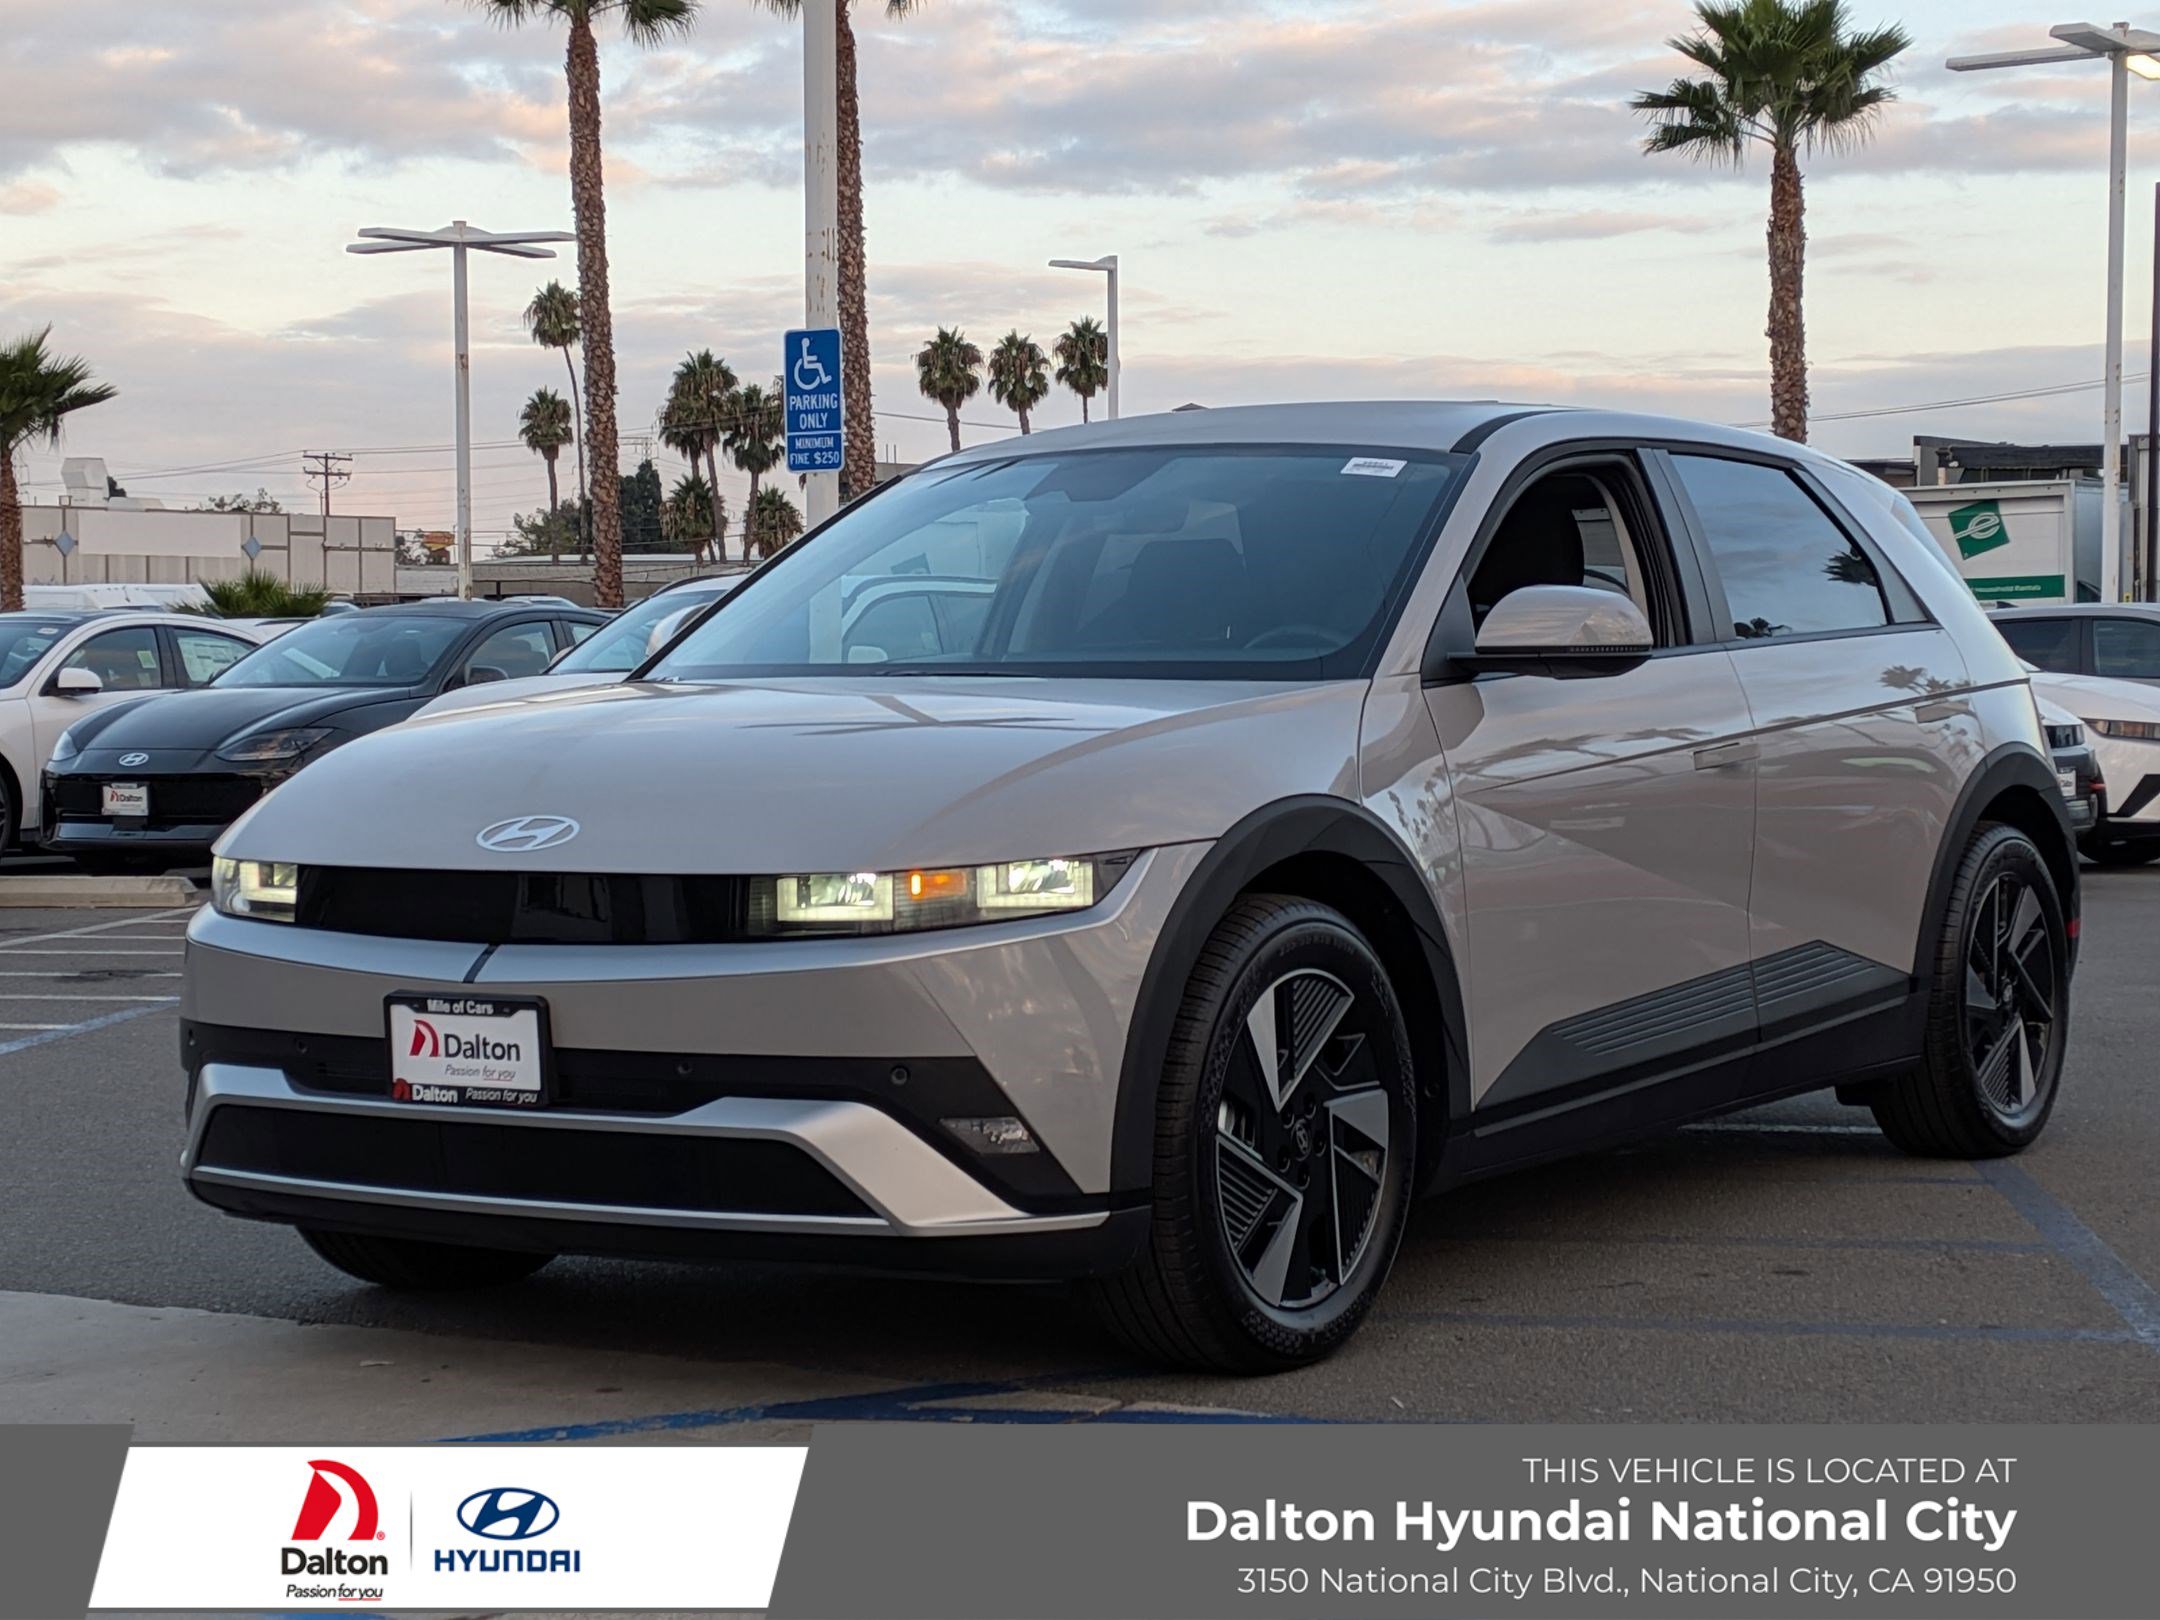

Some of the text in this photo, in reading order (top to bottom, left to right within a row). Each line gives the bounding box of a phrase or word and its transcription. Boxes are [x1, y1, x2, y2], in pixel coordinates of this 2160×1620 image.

[789, 394, 838, 411] PARKING
[799, 412, 828, 429] ONLY
[795, 436, 834, 449] MINIMUM
[790, 451, 840, 465] FINE $250
[427, 999, 494, 1015] Mile of Cars
[444, 1033, 521, 1062] Dalton
[445, 1064, 516, 1080] Passion for you
[412, 1084, 458, 1103] Dalton
[465, 1088, 538, 1104] Passion for you
